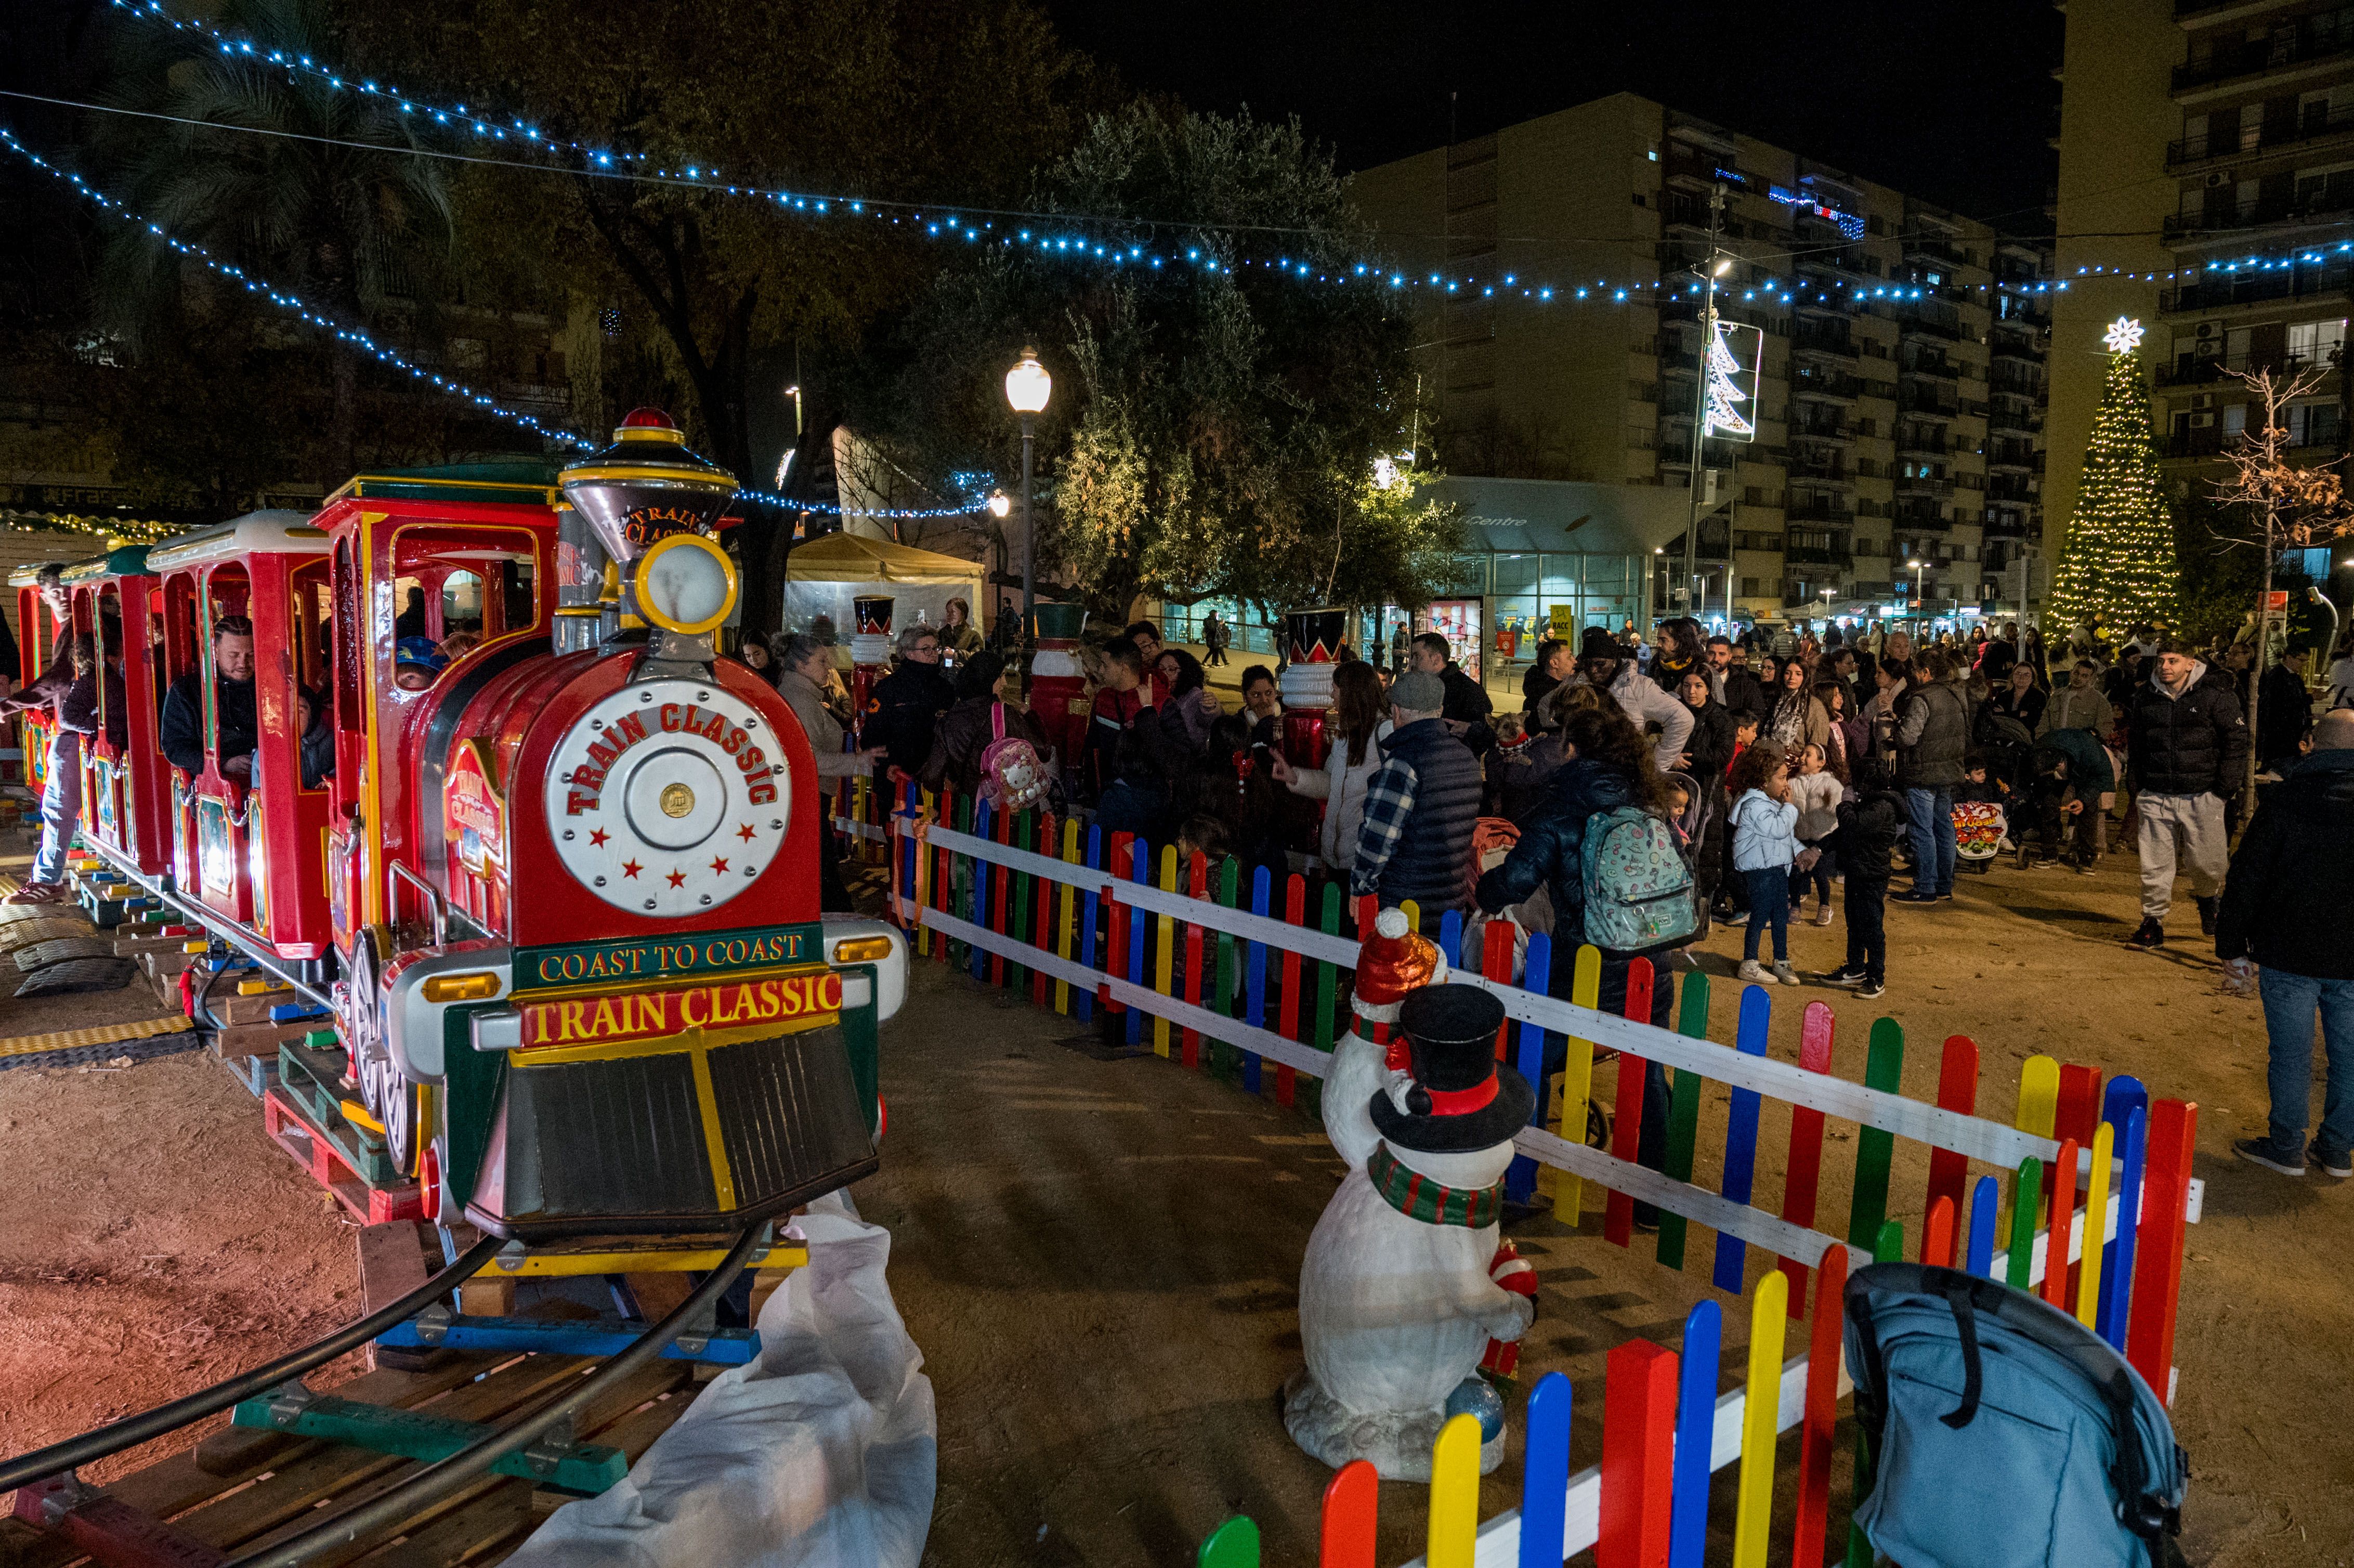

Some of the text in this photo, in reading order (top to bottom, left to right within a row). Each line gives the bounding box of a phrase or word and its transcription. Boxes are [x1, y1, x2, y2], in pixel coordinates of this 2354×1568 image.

[1469, 515, 1527, 526] Centre
[566, 703, 778, 816] TRAIN CLASSIC
[540, 934, 802, 982] COAST TO COAST
[527, 973, 842, 1044] TRAIN CLASSIC
